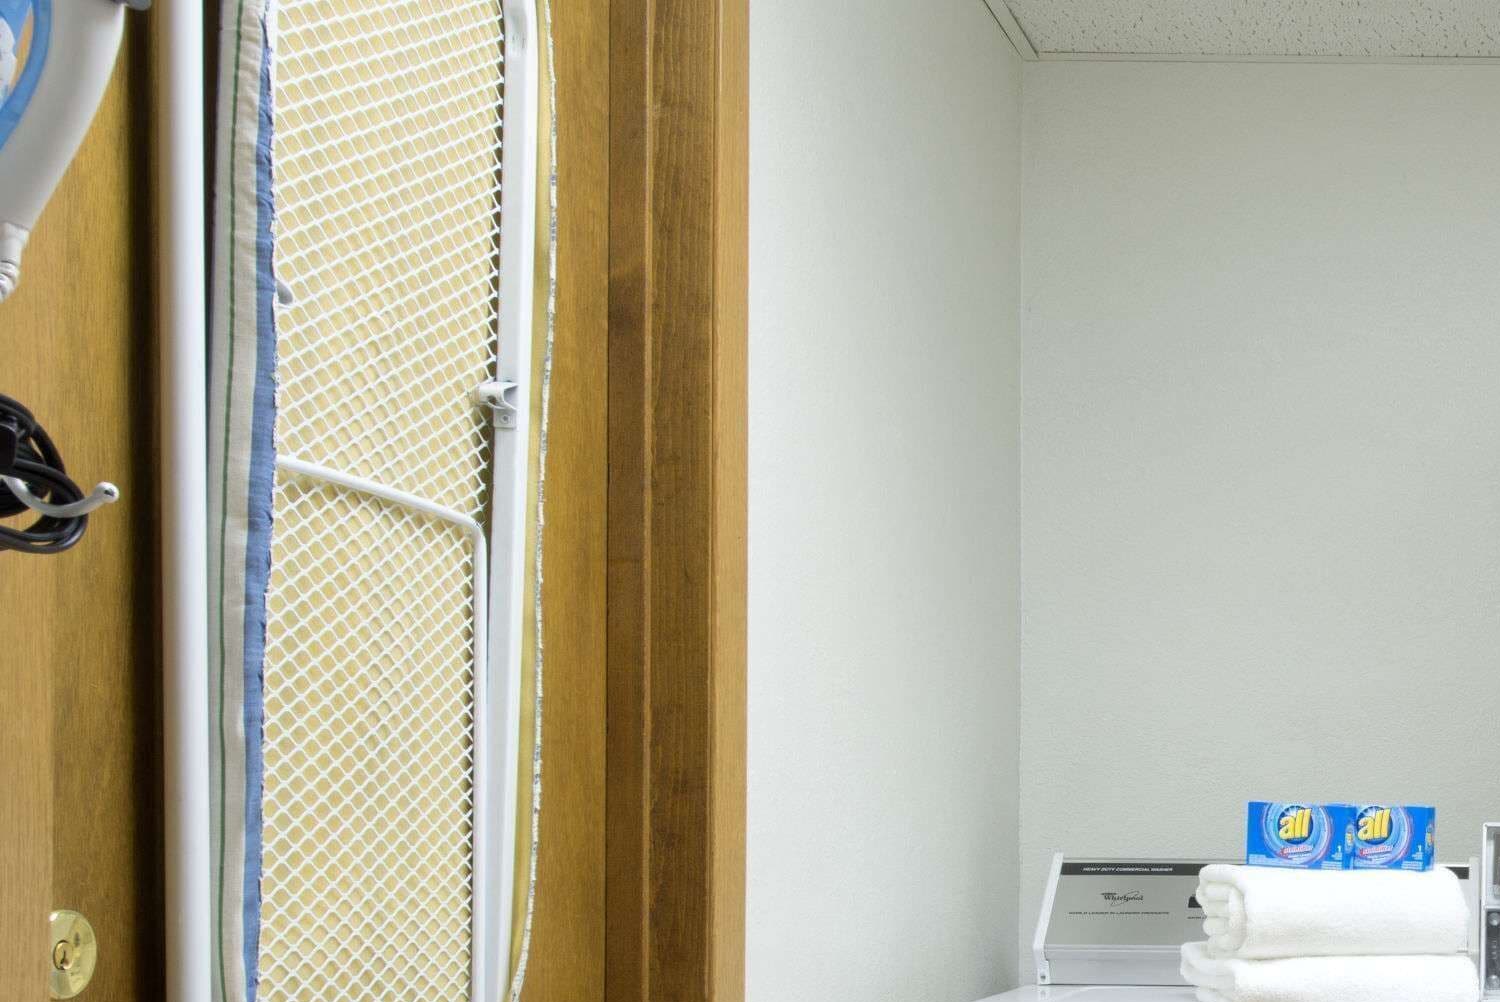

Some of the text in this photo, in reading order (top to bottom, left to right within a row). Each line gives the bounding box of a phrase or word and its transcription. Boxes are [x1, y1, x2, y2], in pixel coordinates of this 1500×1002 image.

[1279, 808, 1312, 840] all
[1357, 808, 1391, 840] all
[1102, 891, 1144, 904] Whirlpool
